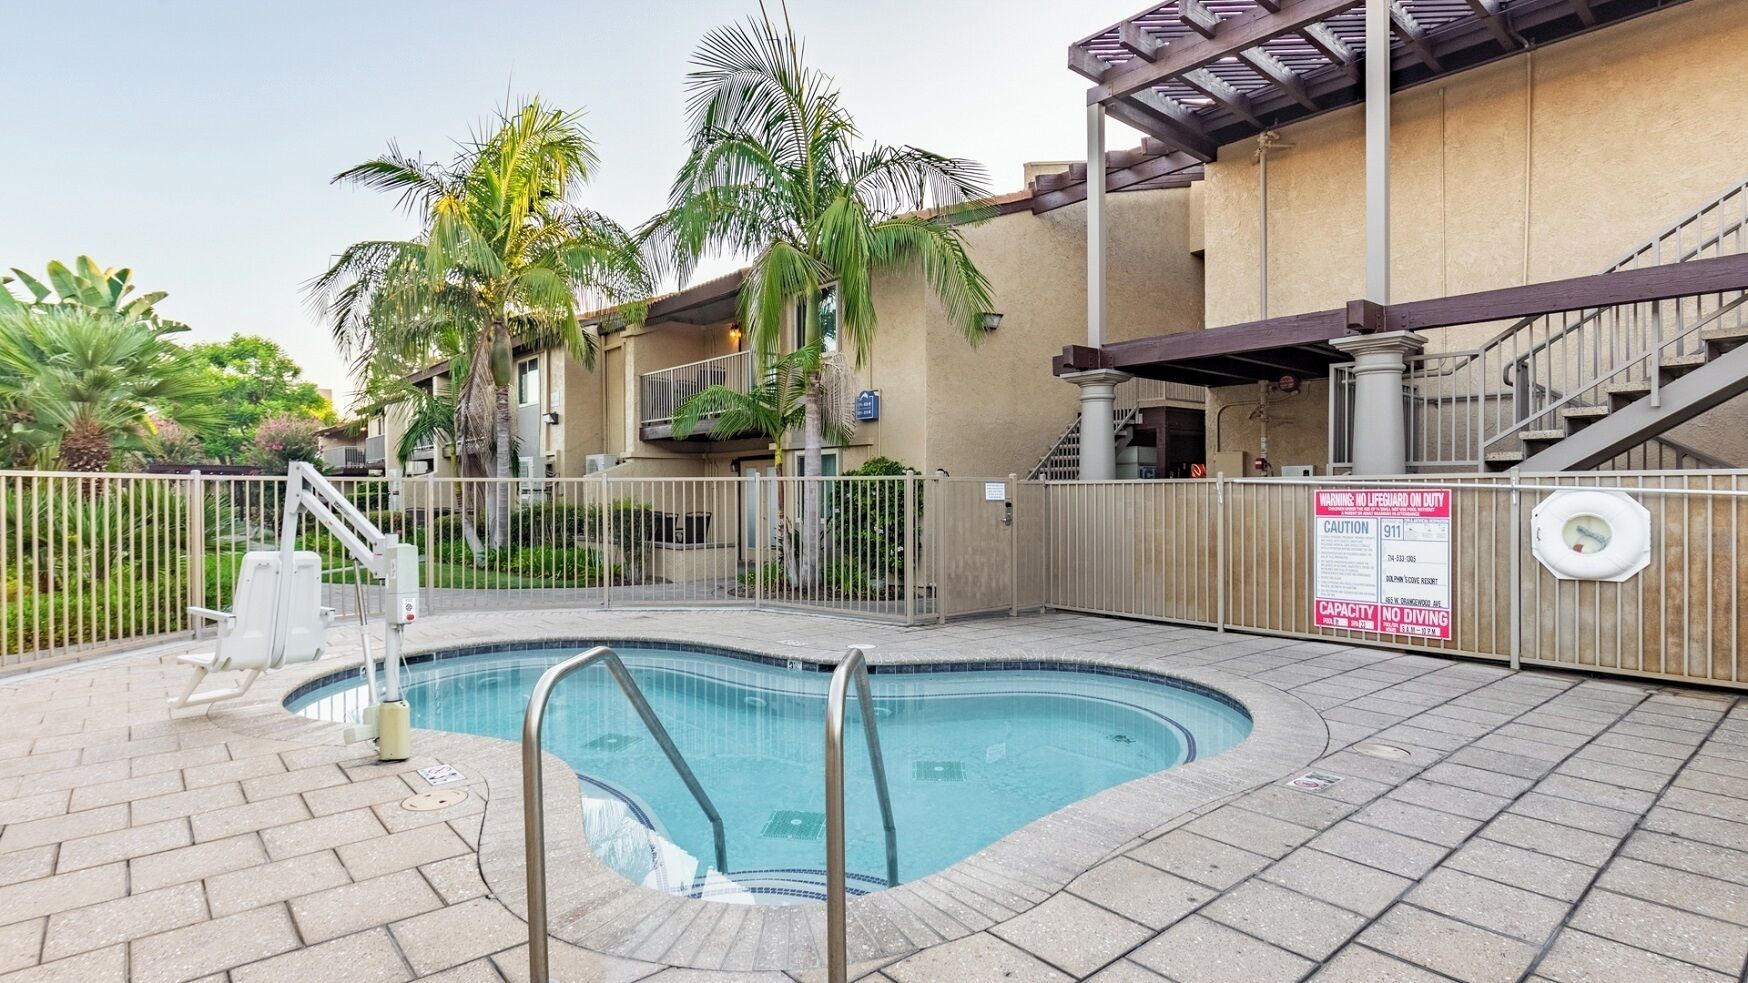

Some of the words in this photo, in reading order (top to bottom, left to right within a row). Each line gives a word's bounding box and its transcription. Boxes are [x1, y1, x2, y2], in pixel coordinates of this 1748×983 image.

[1319, 492, 1354, 507] WARNING:
[1355, 492, 1366, 507] NO
[1367, 492, 1409, 507] LIFEGUARD
[1410, 493, 1422, 507] ON
[1423, 493, 1444, 508] DUTY
[1324, 520, 1369, 534] CAUTION
[1384, 524, 1401, 538] 911
[1408, 576, 1420, 585] COVE
[1421, 577, 1438, 585] RESORT
[1320, 601, 1375, 619] CAPACITY
[1382, 606, 1401, 622] NO
[1403, 608, 1449, 627] DIVING
